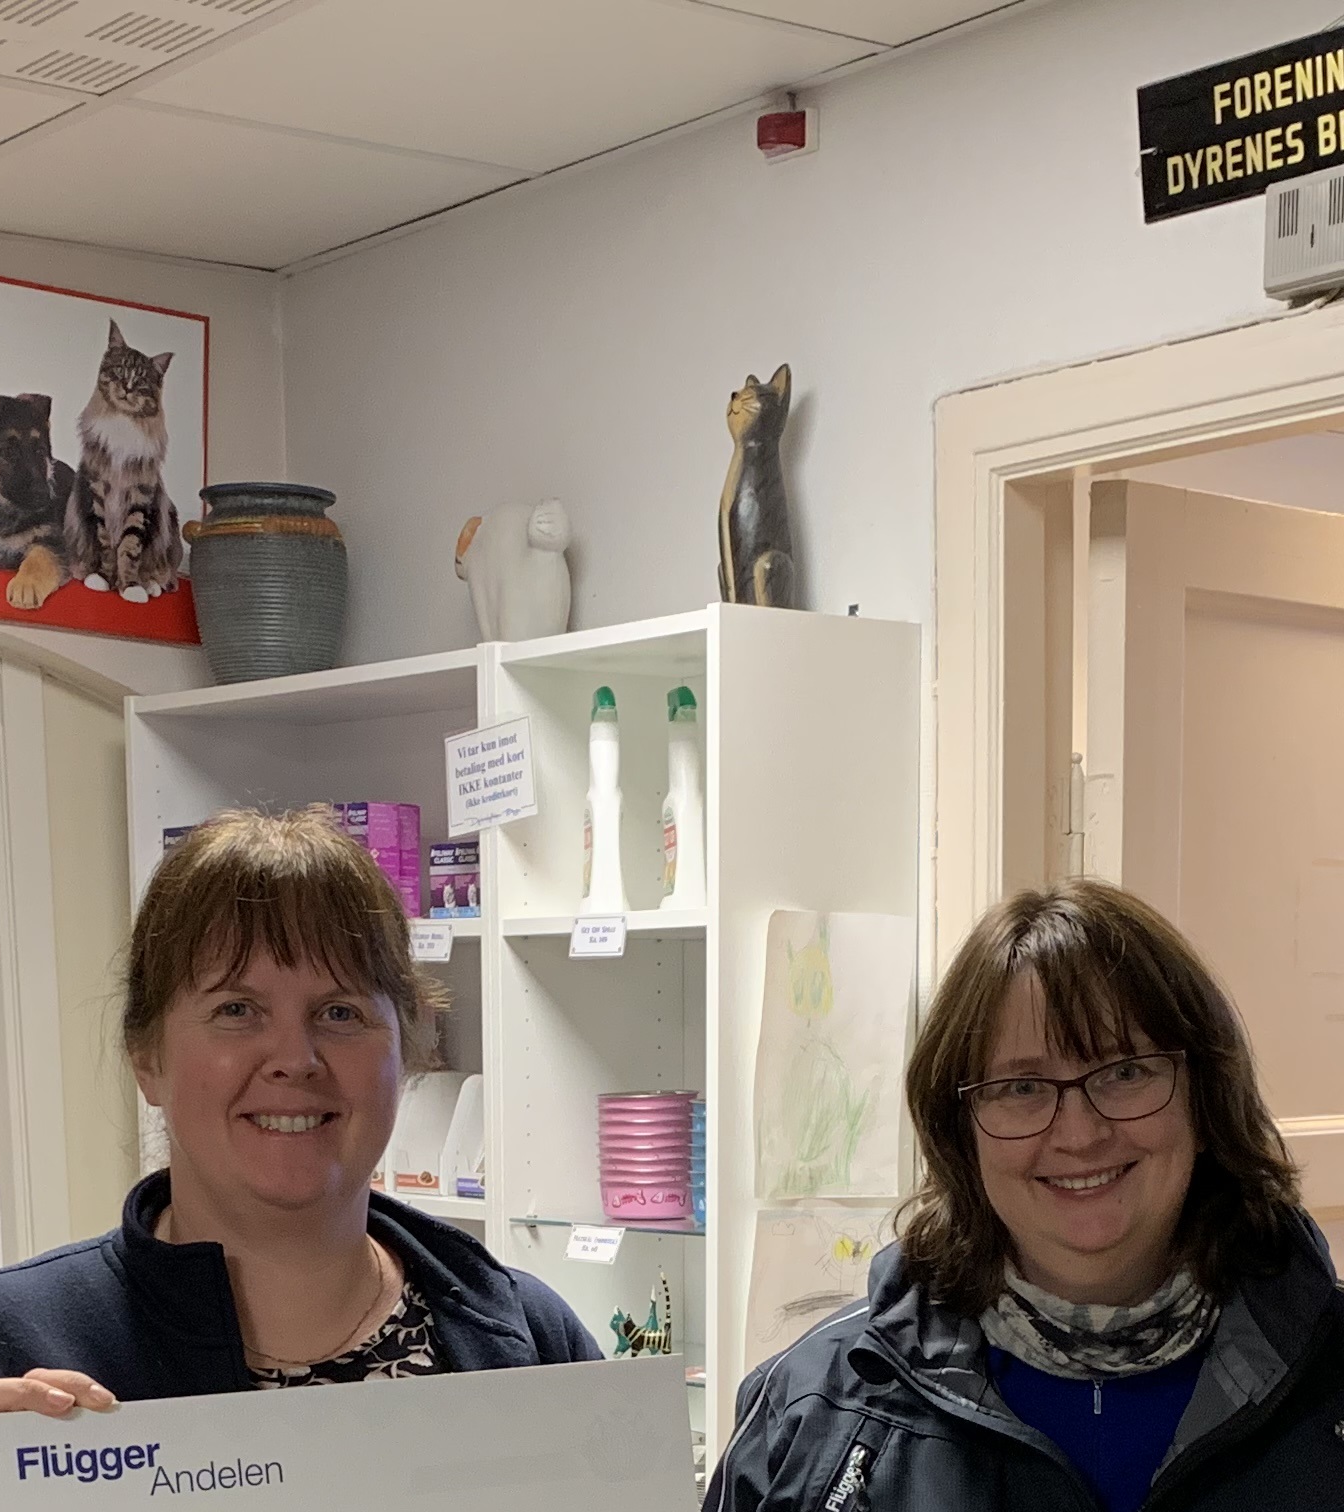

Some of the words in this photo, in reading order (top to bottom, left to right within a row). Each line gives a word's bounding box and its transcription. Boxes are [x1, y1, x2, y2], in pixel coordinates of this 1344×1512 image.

[1166, 122, 1305, 196] DYRENES
[17, 1441, 161, 1483] Flügger
[150, 1457, 284, 1497] Andelen
